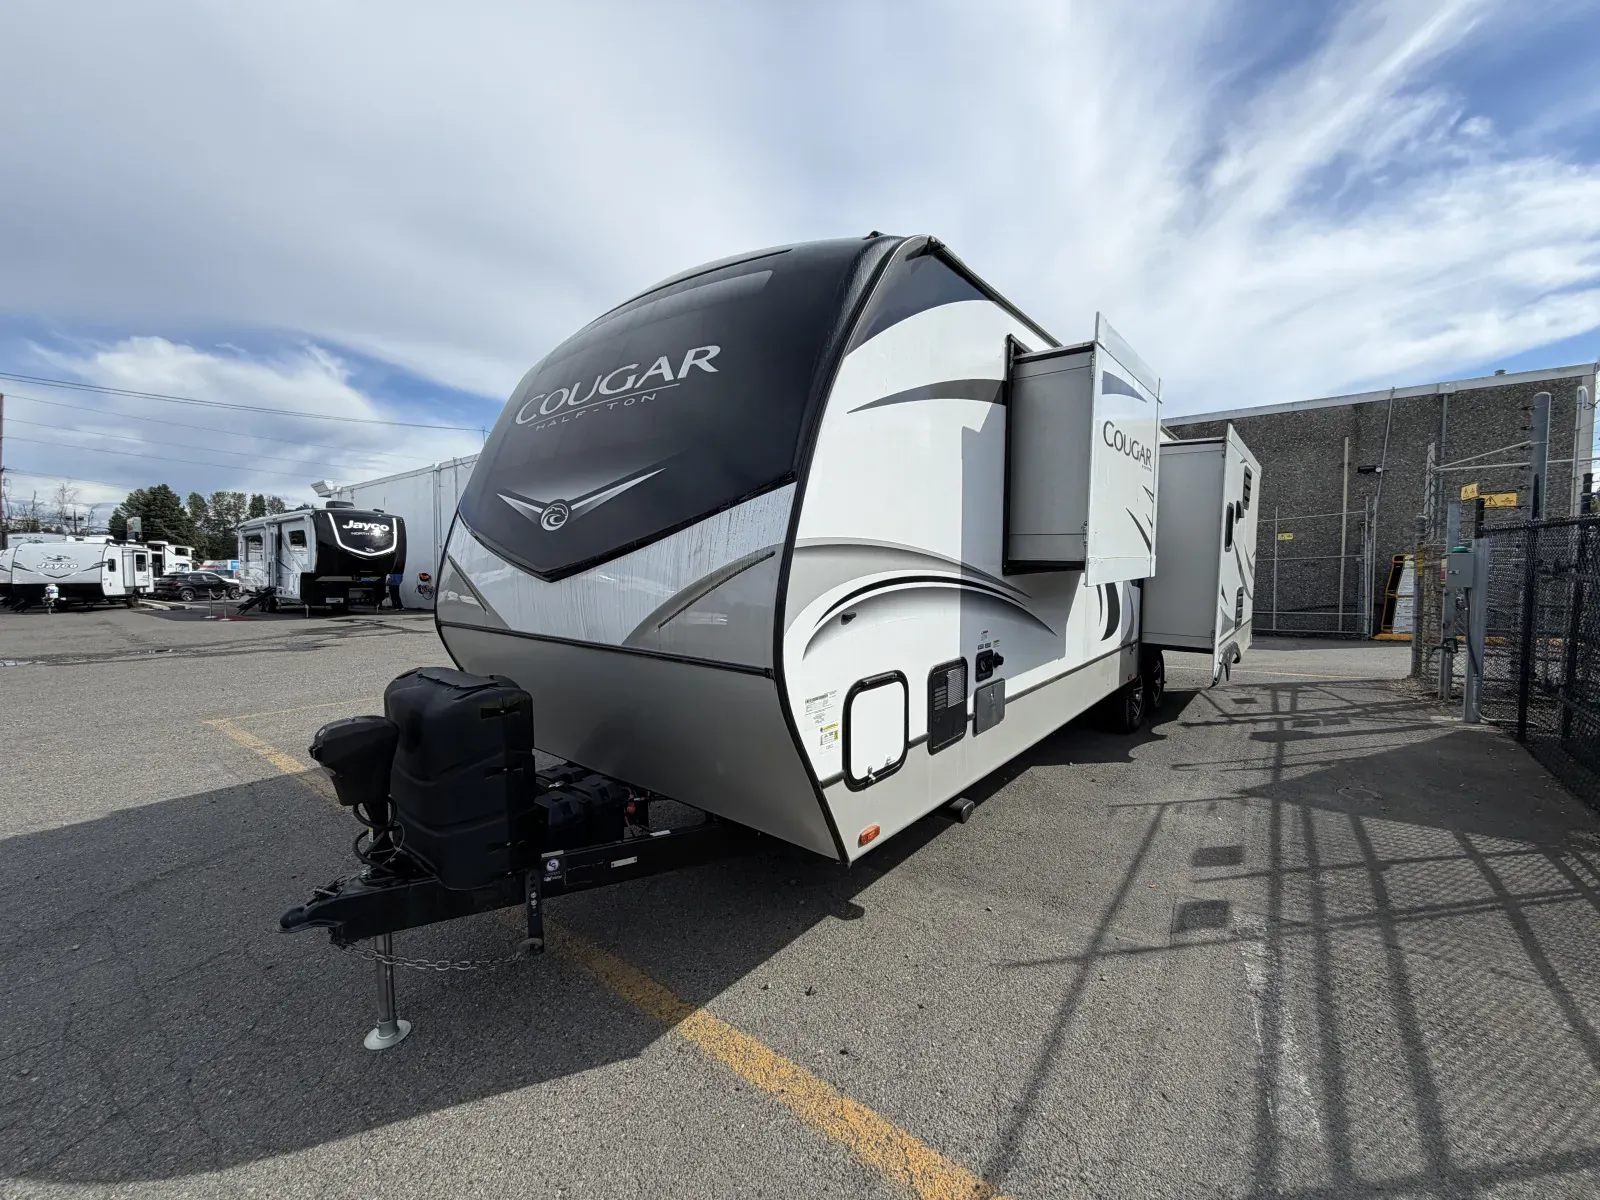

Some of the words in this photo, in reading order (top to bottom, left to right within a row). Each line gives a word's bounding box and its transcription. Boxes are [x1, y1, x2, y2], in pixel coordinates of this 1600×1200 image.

[515, 345, 721, 425] COUGAR
[535, 393, 657, 432] HALF-TON
[1103, 420, 1153, 468] COUGAR
[342, 520, 389, 531] Jayco
[37, 562, 78, 570] Jayco
